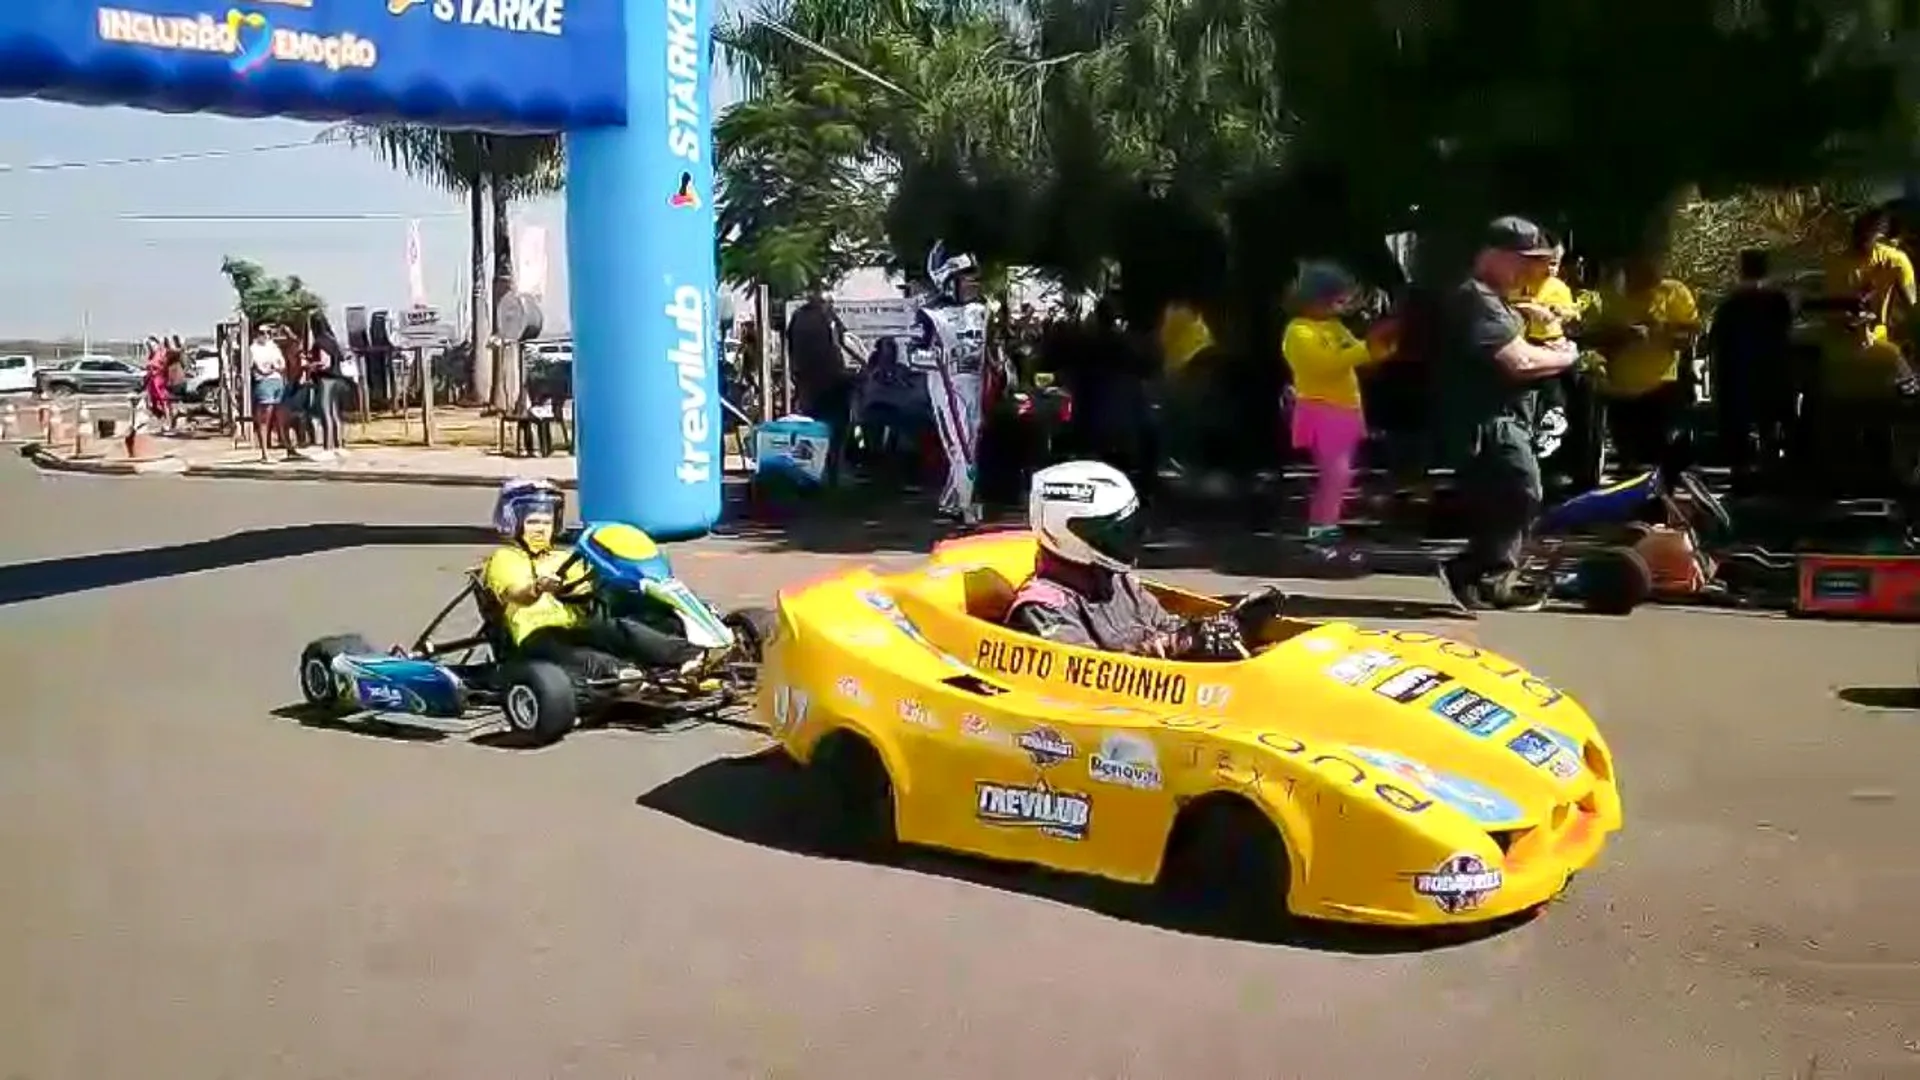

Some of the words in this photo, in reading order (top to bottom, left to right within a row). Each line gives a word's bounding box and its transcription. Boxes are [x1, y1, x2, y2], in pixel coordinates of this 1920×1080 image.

[98, 7, 237, 53] INCLUSÃO
[273, 28, 378, 71] EMOÇÃO
[432, 0, 563, 35] STARKE
[665, 284, 711, 484] trevilub
[977, 638, 1051, 680] PILOTO
[1066, 656, 1186, 705] NEGUINHO
[980, 785, 1088, 826] TREVILUB
